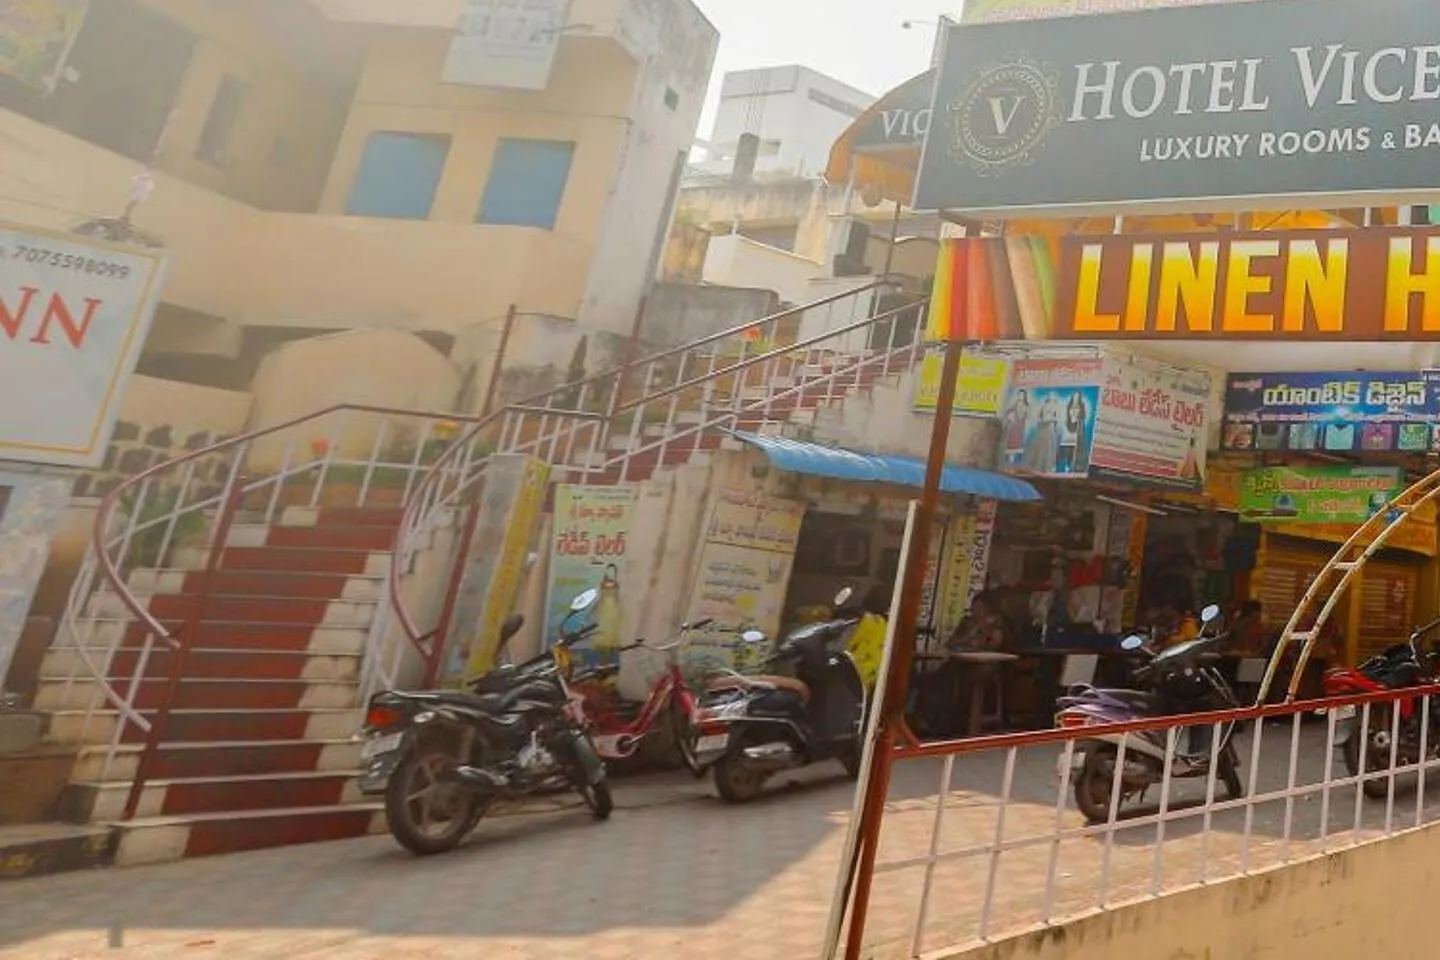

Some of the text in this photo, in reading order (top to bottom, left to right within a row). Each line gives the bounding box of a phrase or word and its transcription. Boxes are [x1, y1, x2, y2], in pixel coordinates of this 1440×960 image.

[1067, 57, 1270, 123] HOTEL
[1139, 132, 1249, 162] LUXURY
[1258, 127, 1371, 159] ROOMS
[1381, 131, 1396, 150] &
[1073, 237, 1349, 334] LINEN
